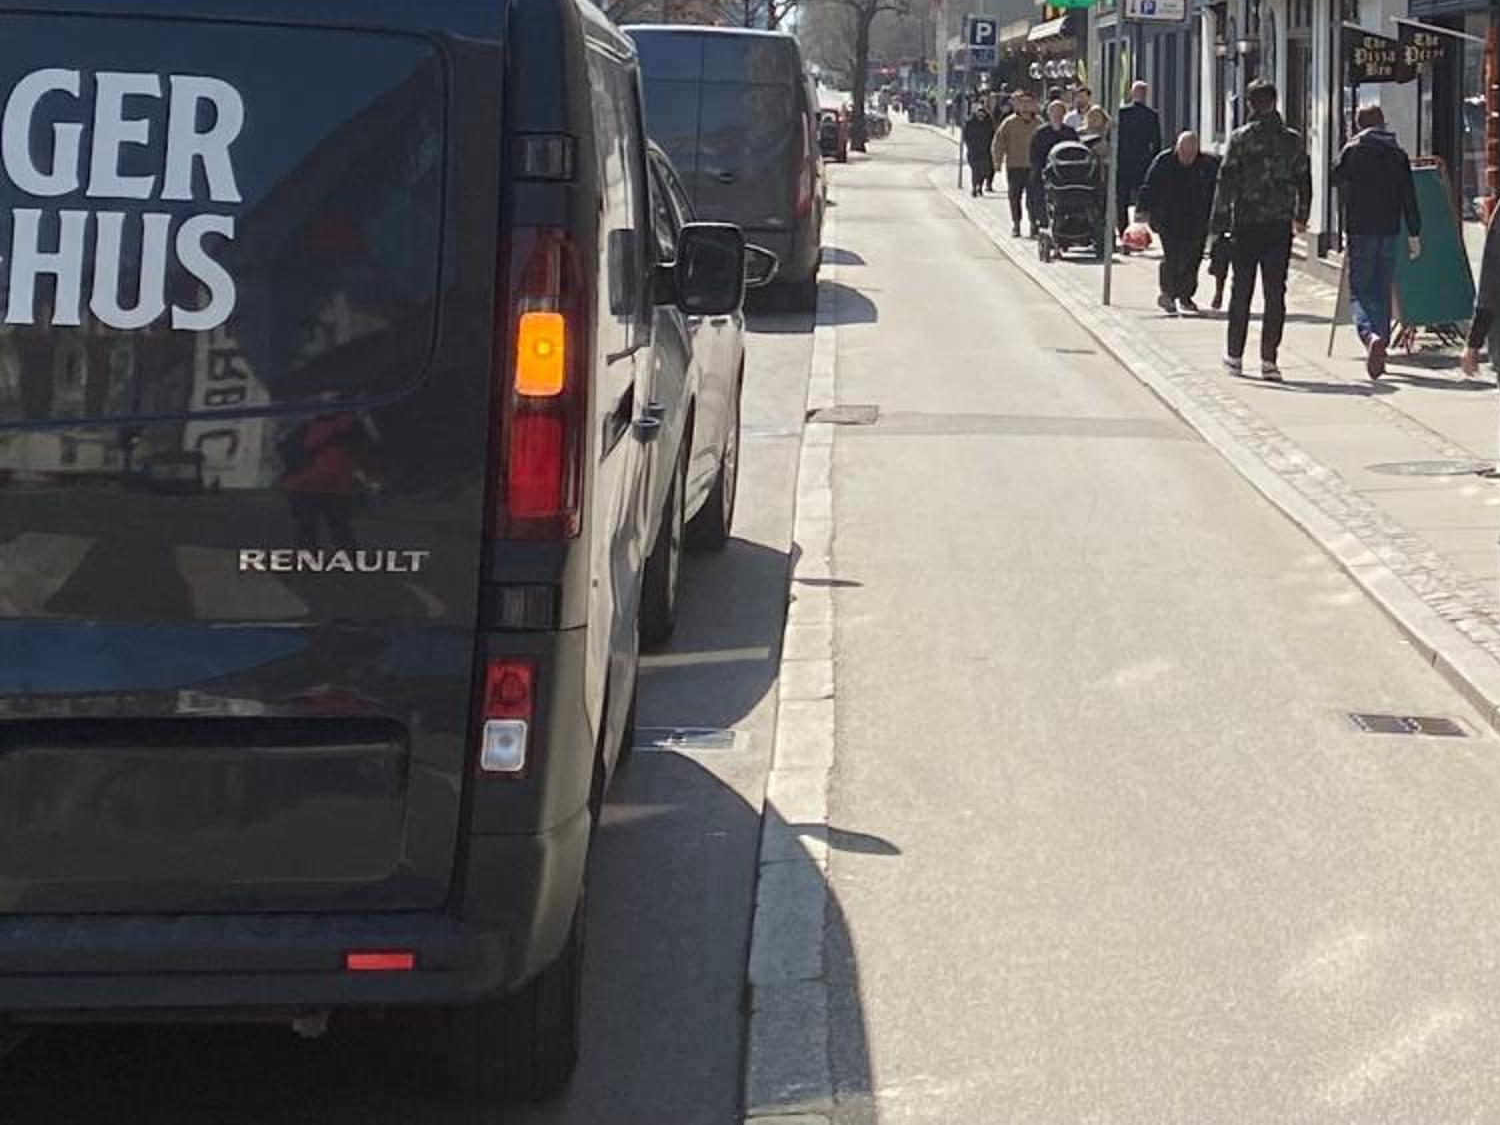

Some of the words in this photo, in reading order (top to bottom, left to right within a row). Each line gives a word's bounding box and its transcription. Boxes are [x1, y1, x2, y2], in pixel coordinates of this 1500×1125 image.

[976, 22, 992, 43] P
[2, 68, 244, 202] GER
[4, 208, 237, 331] HUS
[239, 548, 430, 572] RENAULT
